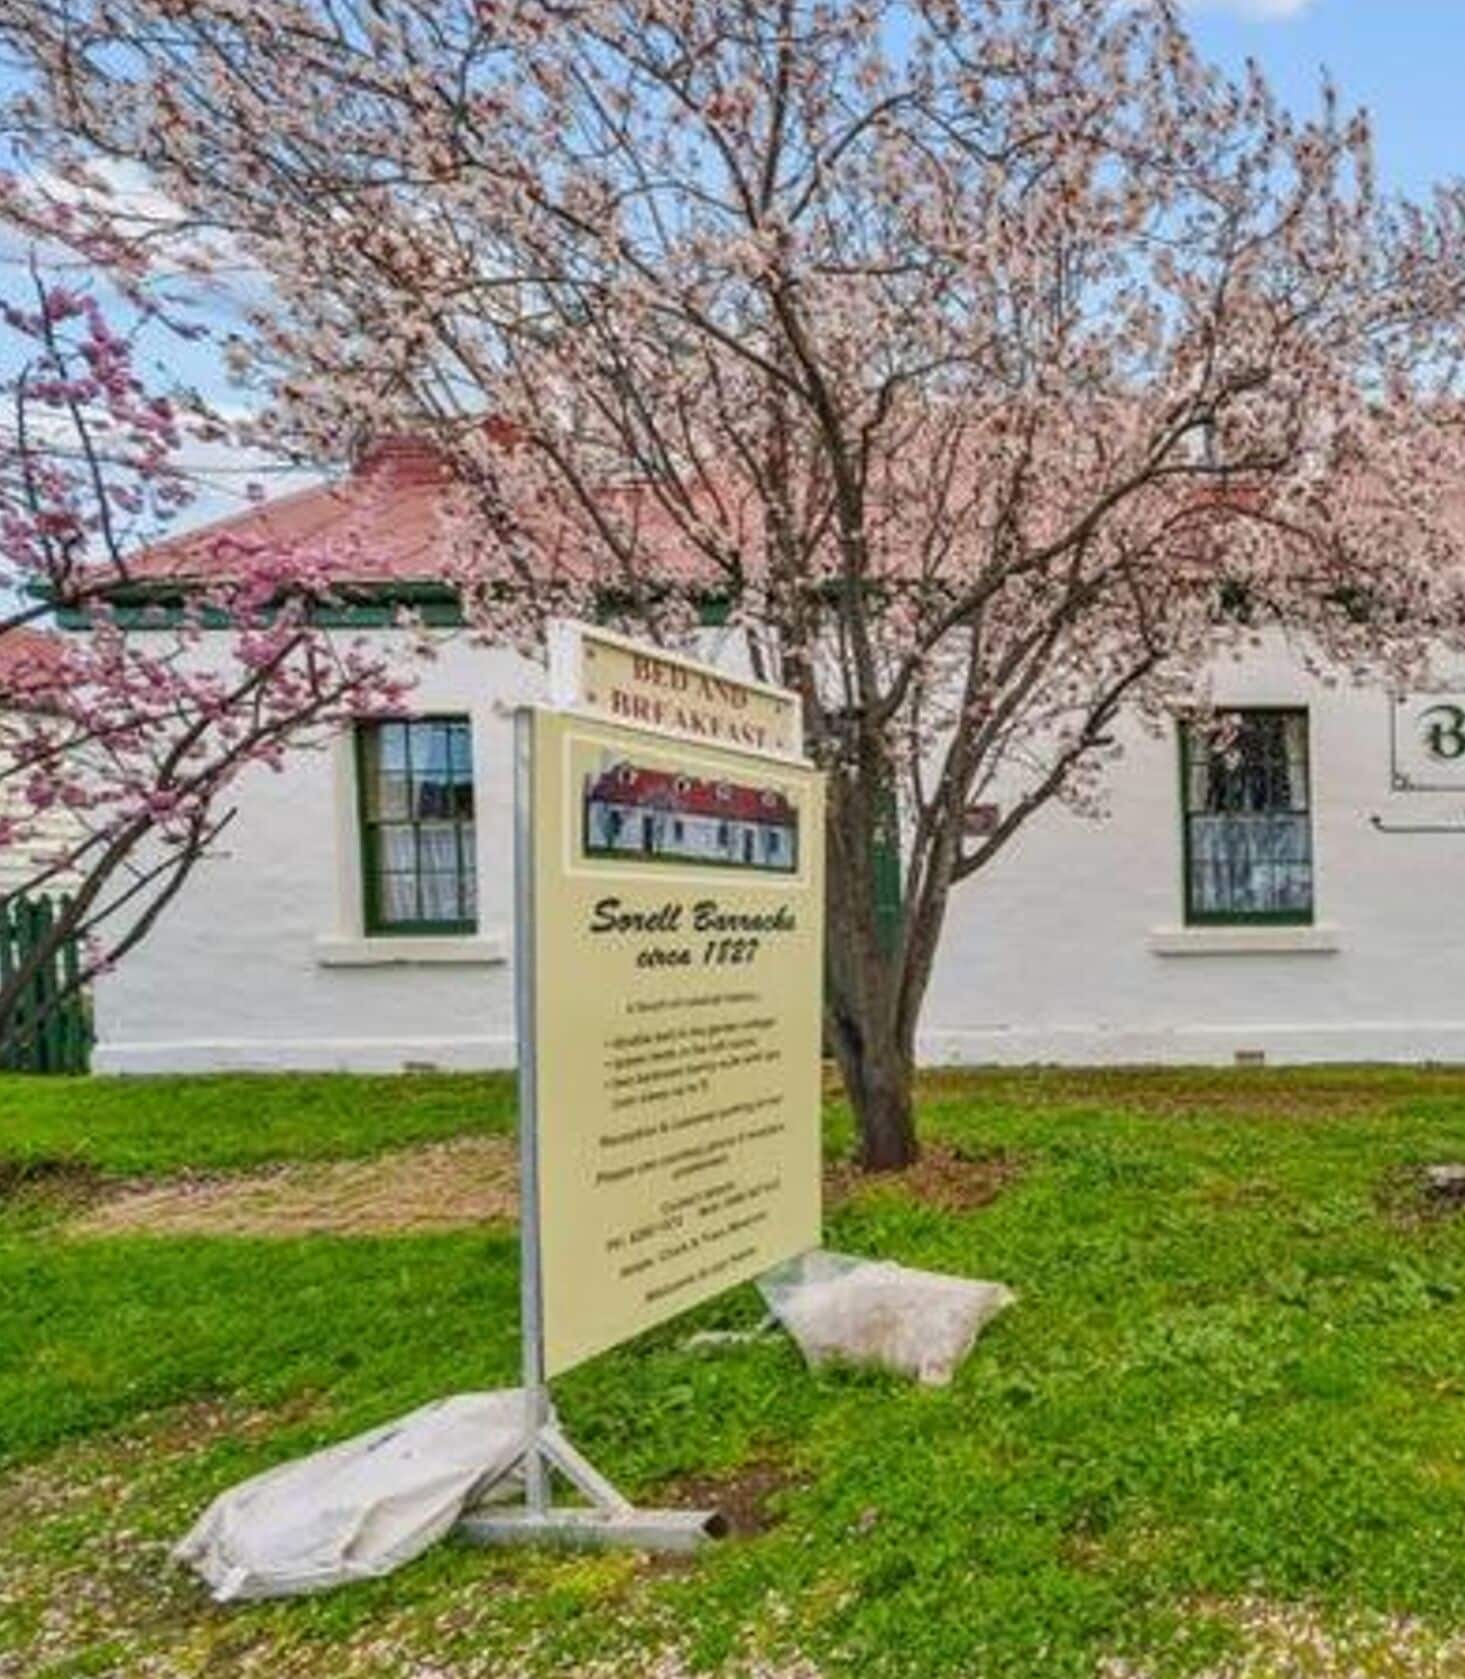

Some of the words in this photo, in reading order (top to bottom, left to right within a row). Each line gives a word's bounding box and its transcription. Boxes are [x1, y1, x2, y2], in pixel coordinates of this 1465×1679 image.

[633, 655, 689, 695] BED
[697, 678, 749, 711] AND
[611, 688, 768, 748] BREAKFAST
[589, 897, 683, 934] Sorell
[692, 899, 797, 933] Barracks
[636, 946, 692, 969] circa
